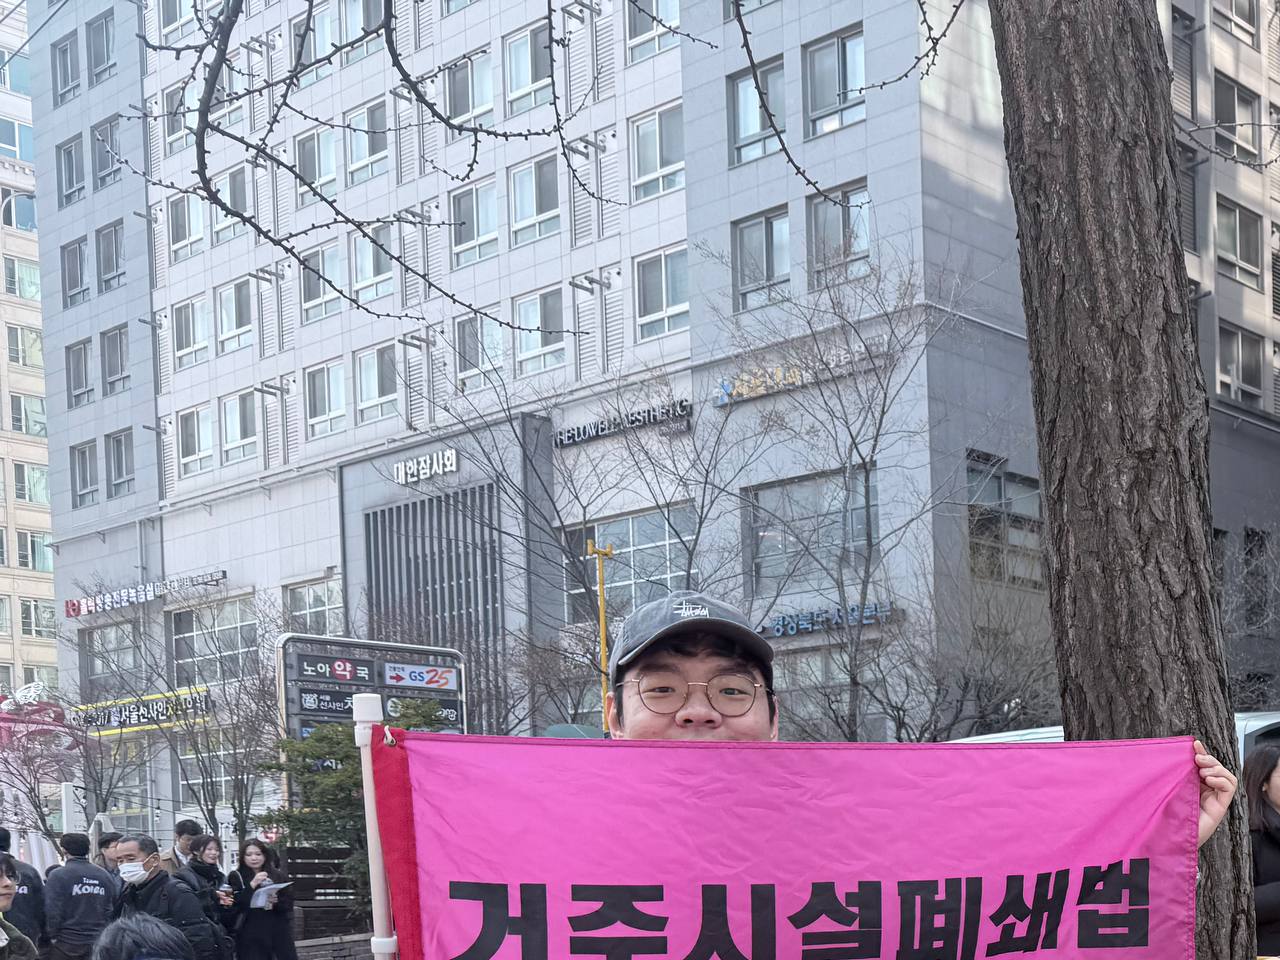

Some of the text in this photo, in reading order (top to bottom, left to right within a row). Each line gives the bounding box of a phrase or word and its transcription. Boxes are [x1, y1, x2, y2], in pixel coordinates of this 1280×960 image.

[393, 448, 457, 485] 대한잠사회
[303, 660, 369, 681] 노아약국
[409, 668, 453, 688] GS25
[72, 884, 105, 896] Korea
